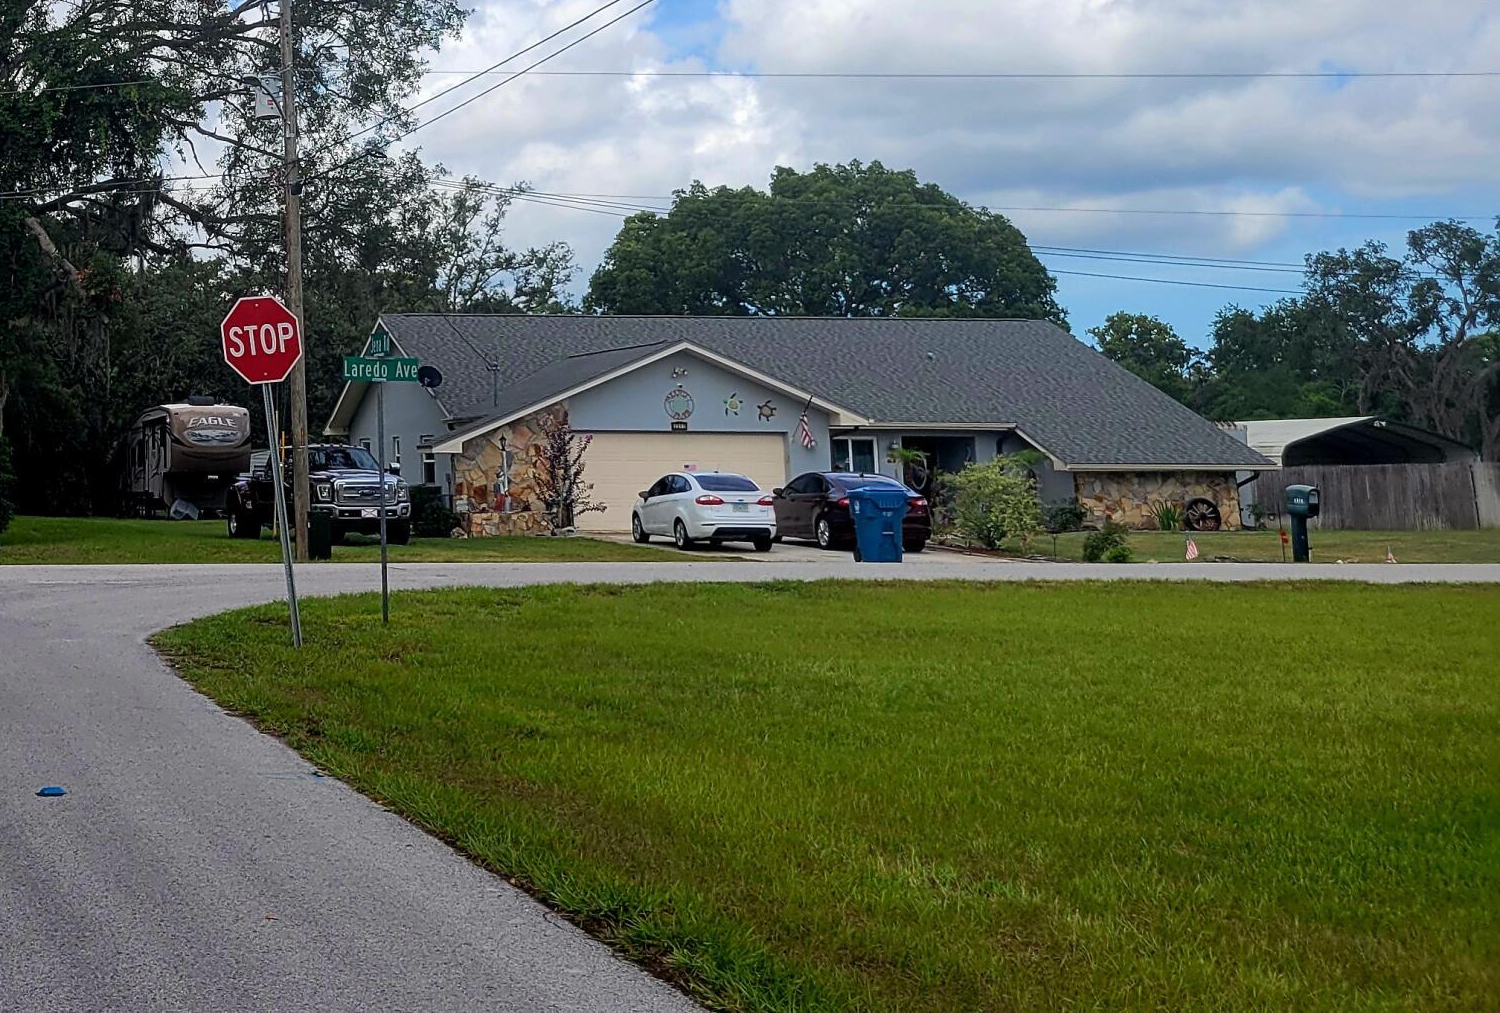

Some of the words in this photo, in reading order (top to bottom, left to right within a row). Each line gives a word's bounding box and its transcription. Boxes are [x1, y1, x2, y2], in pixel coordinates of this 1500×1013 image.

[229, 322, 294, 357] STOP
[344, 360, 388, 377] Laredo
[395, 360, 418, 378] Ave
[187, 416, 238, 428] EAGLE
